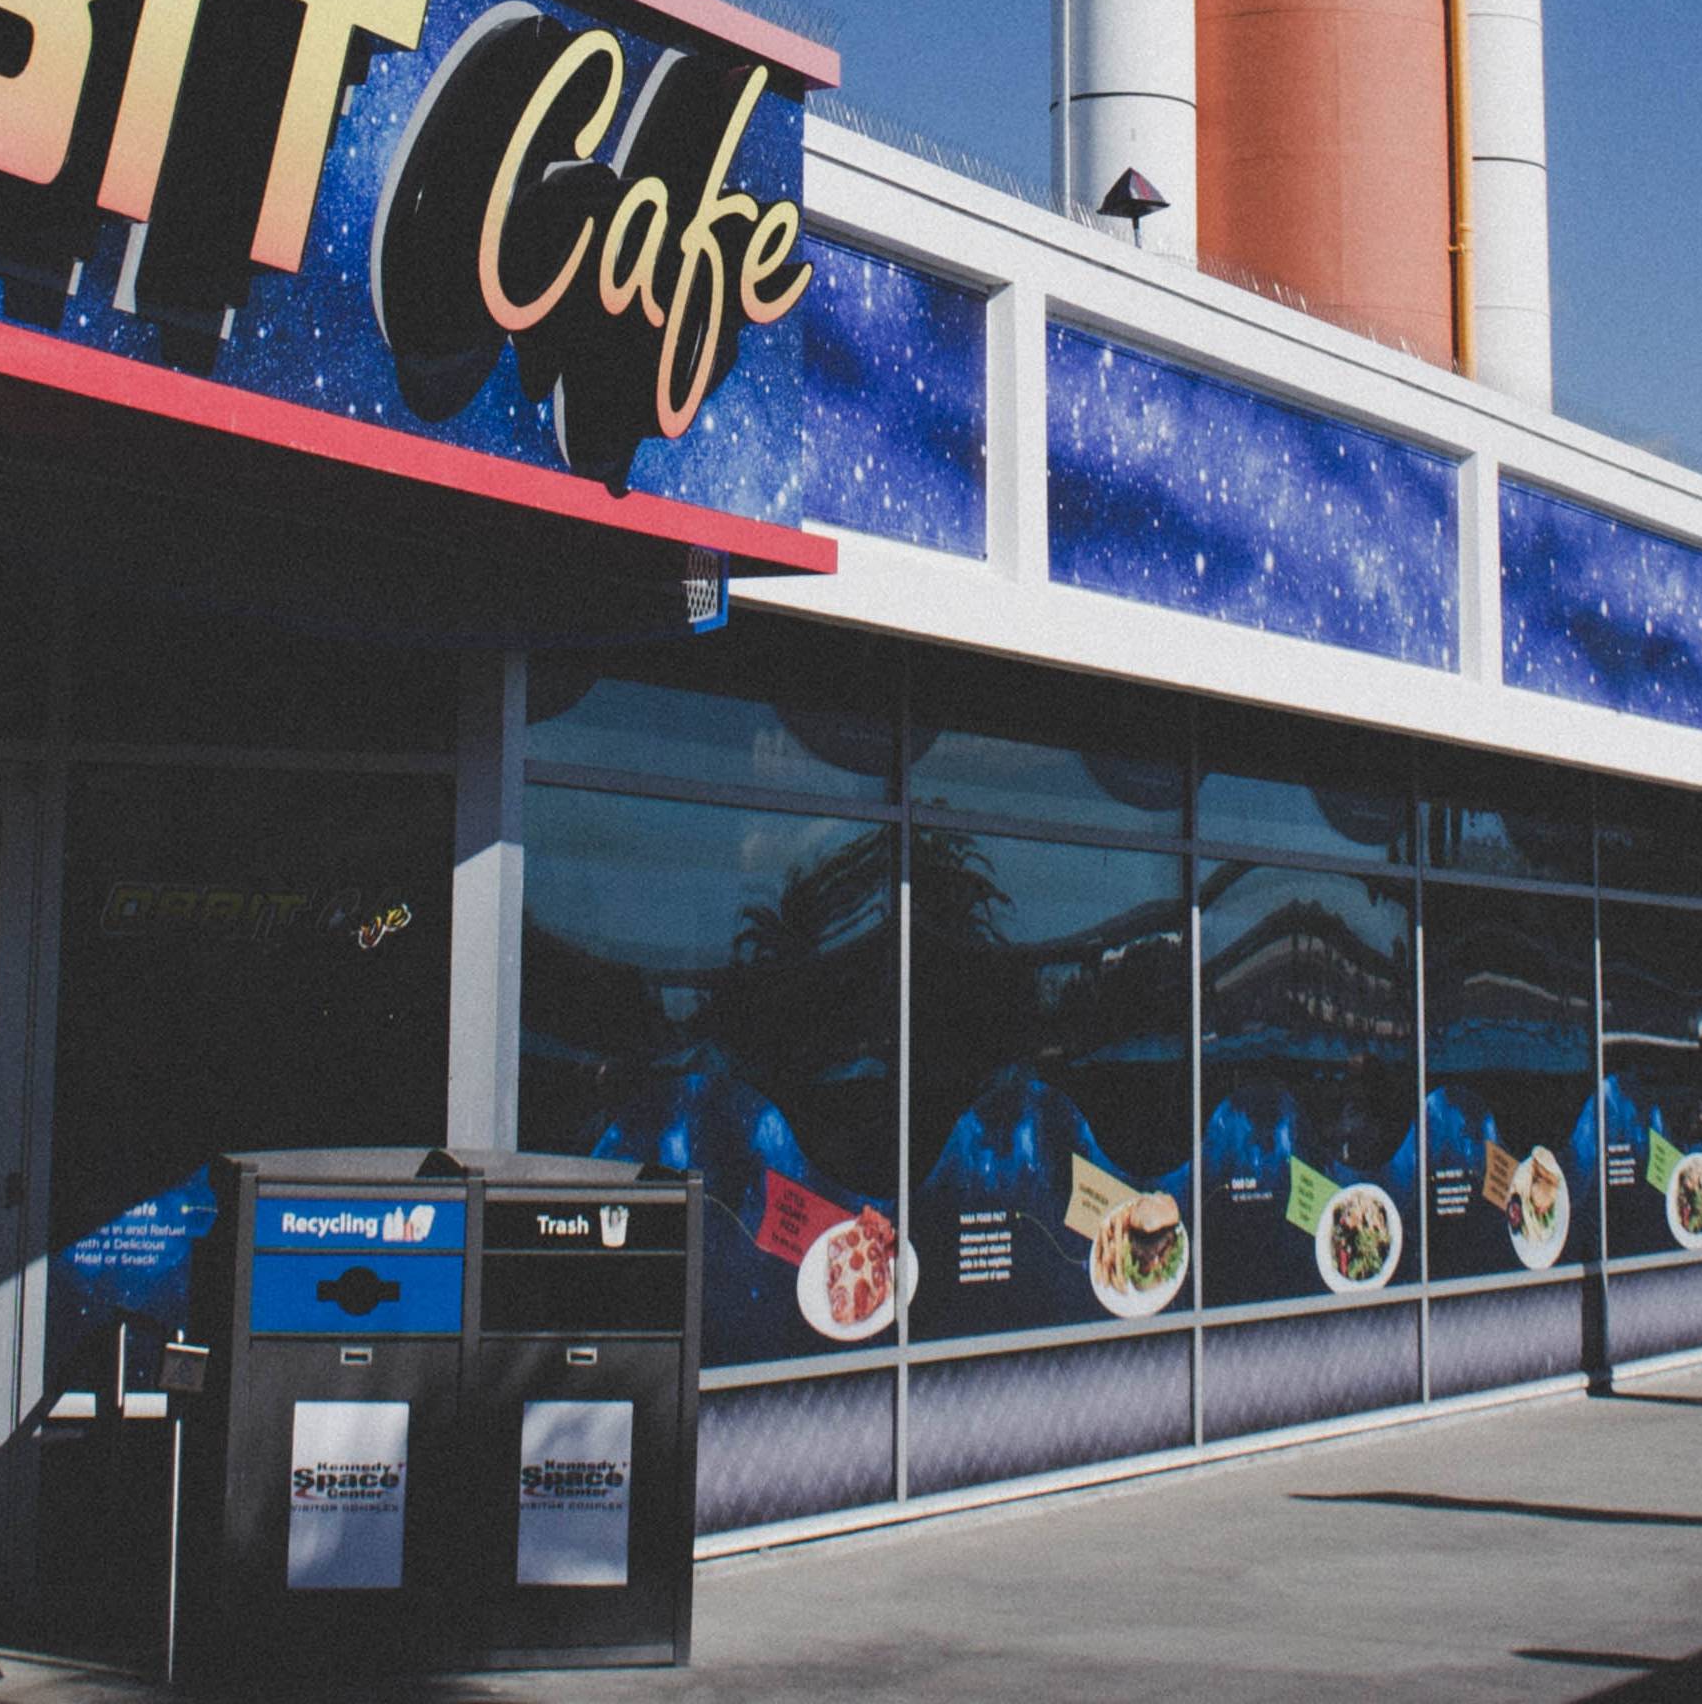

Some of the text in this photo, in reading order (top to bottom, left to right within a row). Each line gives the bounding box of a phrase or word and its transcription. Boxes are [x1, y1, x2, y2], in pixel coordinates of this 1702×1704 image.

[478, 29, 814, 438] Cafe
[125, 1224, 147, 1236] and
[150, 1223, 186, 1237] Refuel
[281, 1212, 378, 1239] Recycling
[537, 1214, 589, 1236] Trash
[114, 1238, 165, 1251] Delicious
[74, 1252, 102, 1264] Meal
[104, 1254, 117, 1264] or
[316, 1461, 391, 1473] Kennedy
[544, 1460, 616, 1472] Kennedy
[293, 1467, 400, 1492] Space
[521, 1465, 624, 1491] Space
[327, 1488, 384, 1499] Center
[554, 1487, 608, 1497] Center
